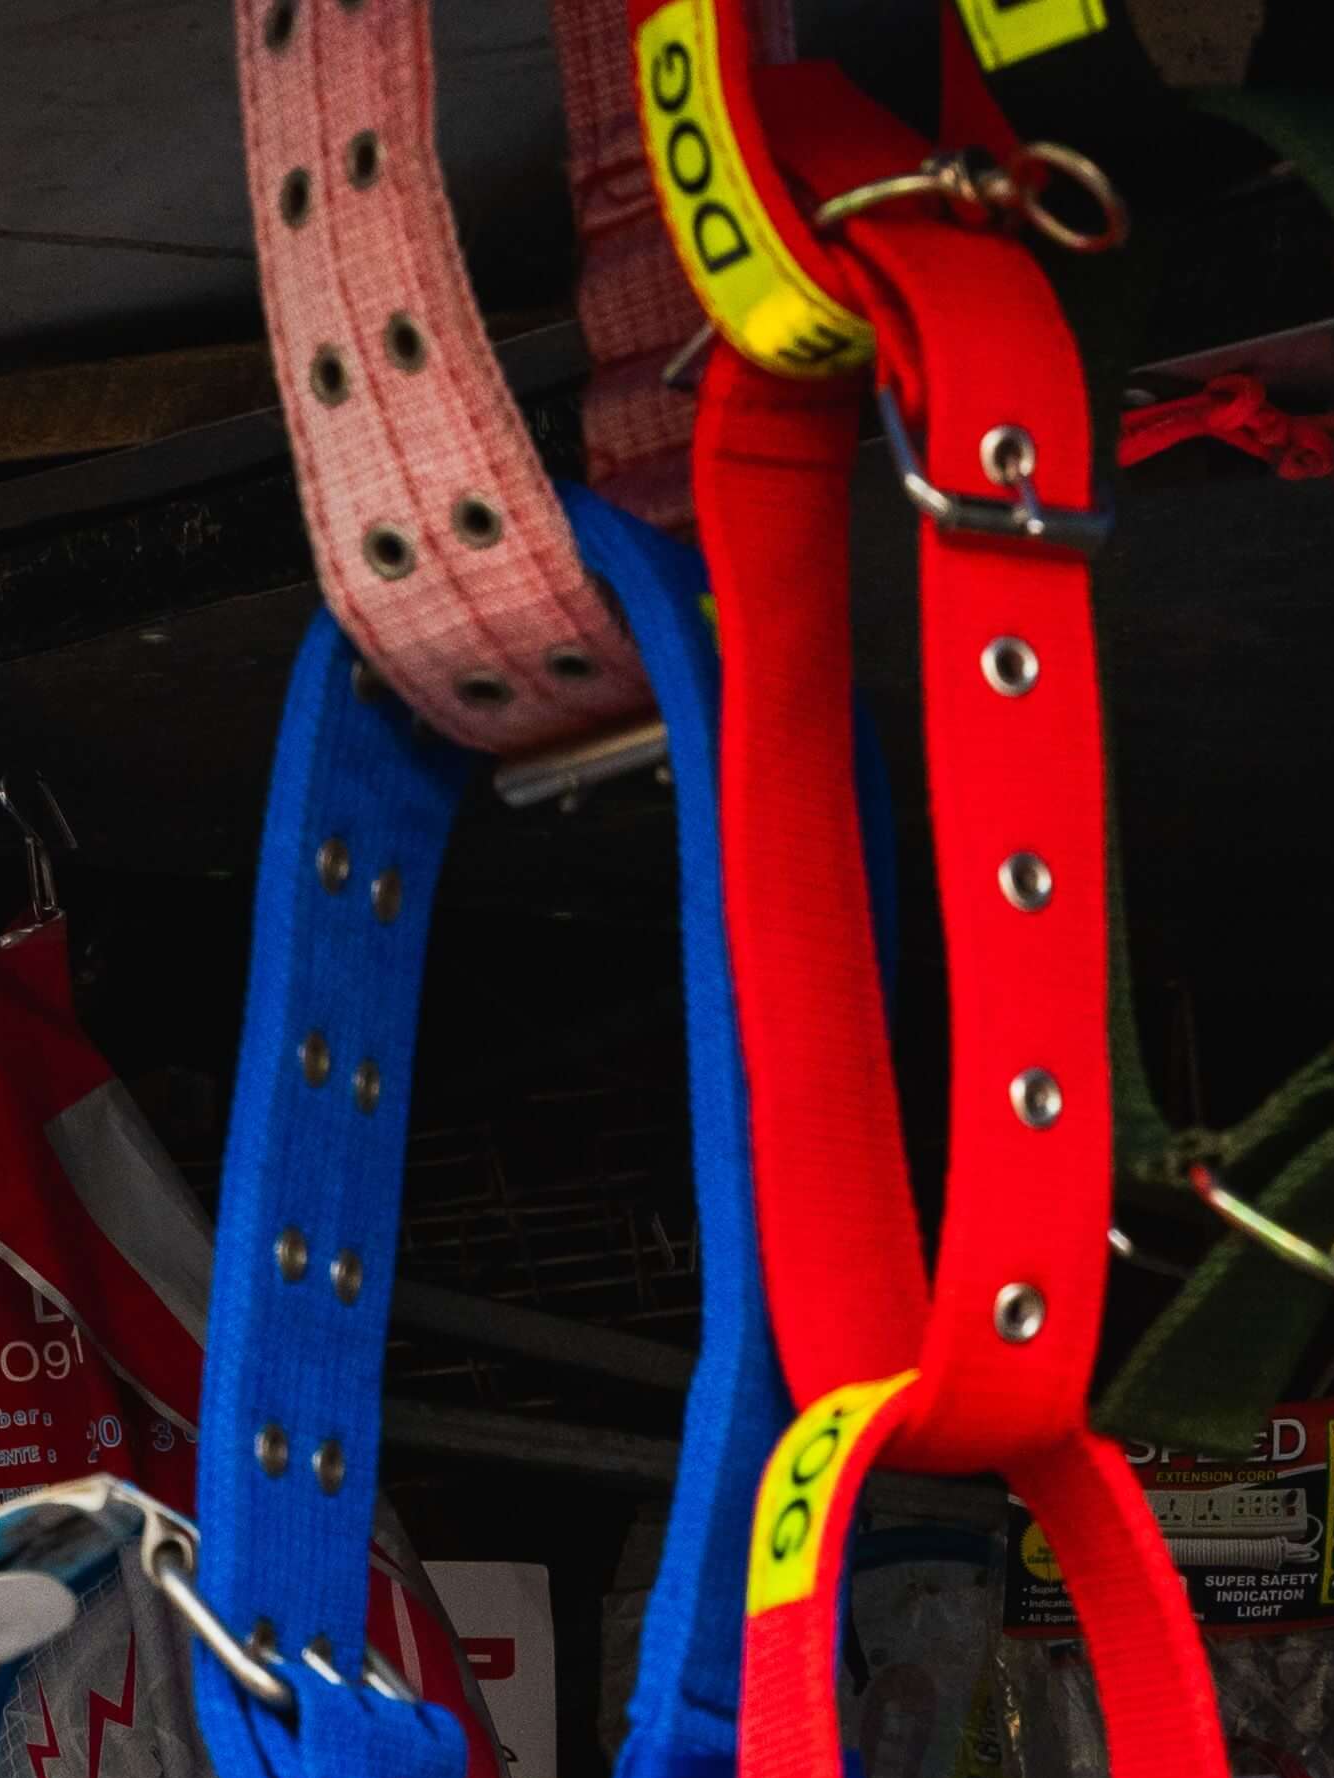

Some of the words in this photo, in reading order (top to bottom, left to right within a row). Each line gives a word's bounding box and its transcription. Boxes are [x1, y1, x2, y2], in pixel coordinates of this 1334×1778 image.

[650, 41, 753, 275] DOG
[1156, 1471, 1233, 1483] EXTENSION
[1237, 1470, 1275, 1483] CORD
[1205, 1575, 1256, 1587] SUPER
[1261, 1573, 1317, 1586] SAFETY
[1217, 1589, 1304, 1601] INDICATION
[1237, 1605, 1282, 1616] LIGHT
